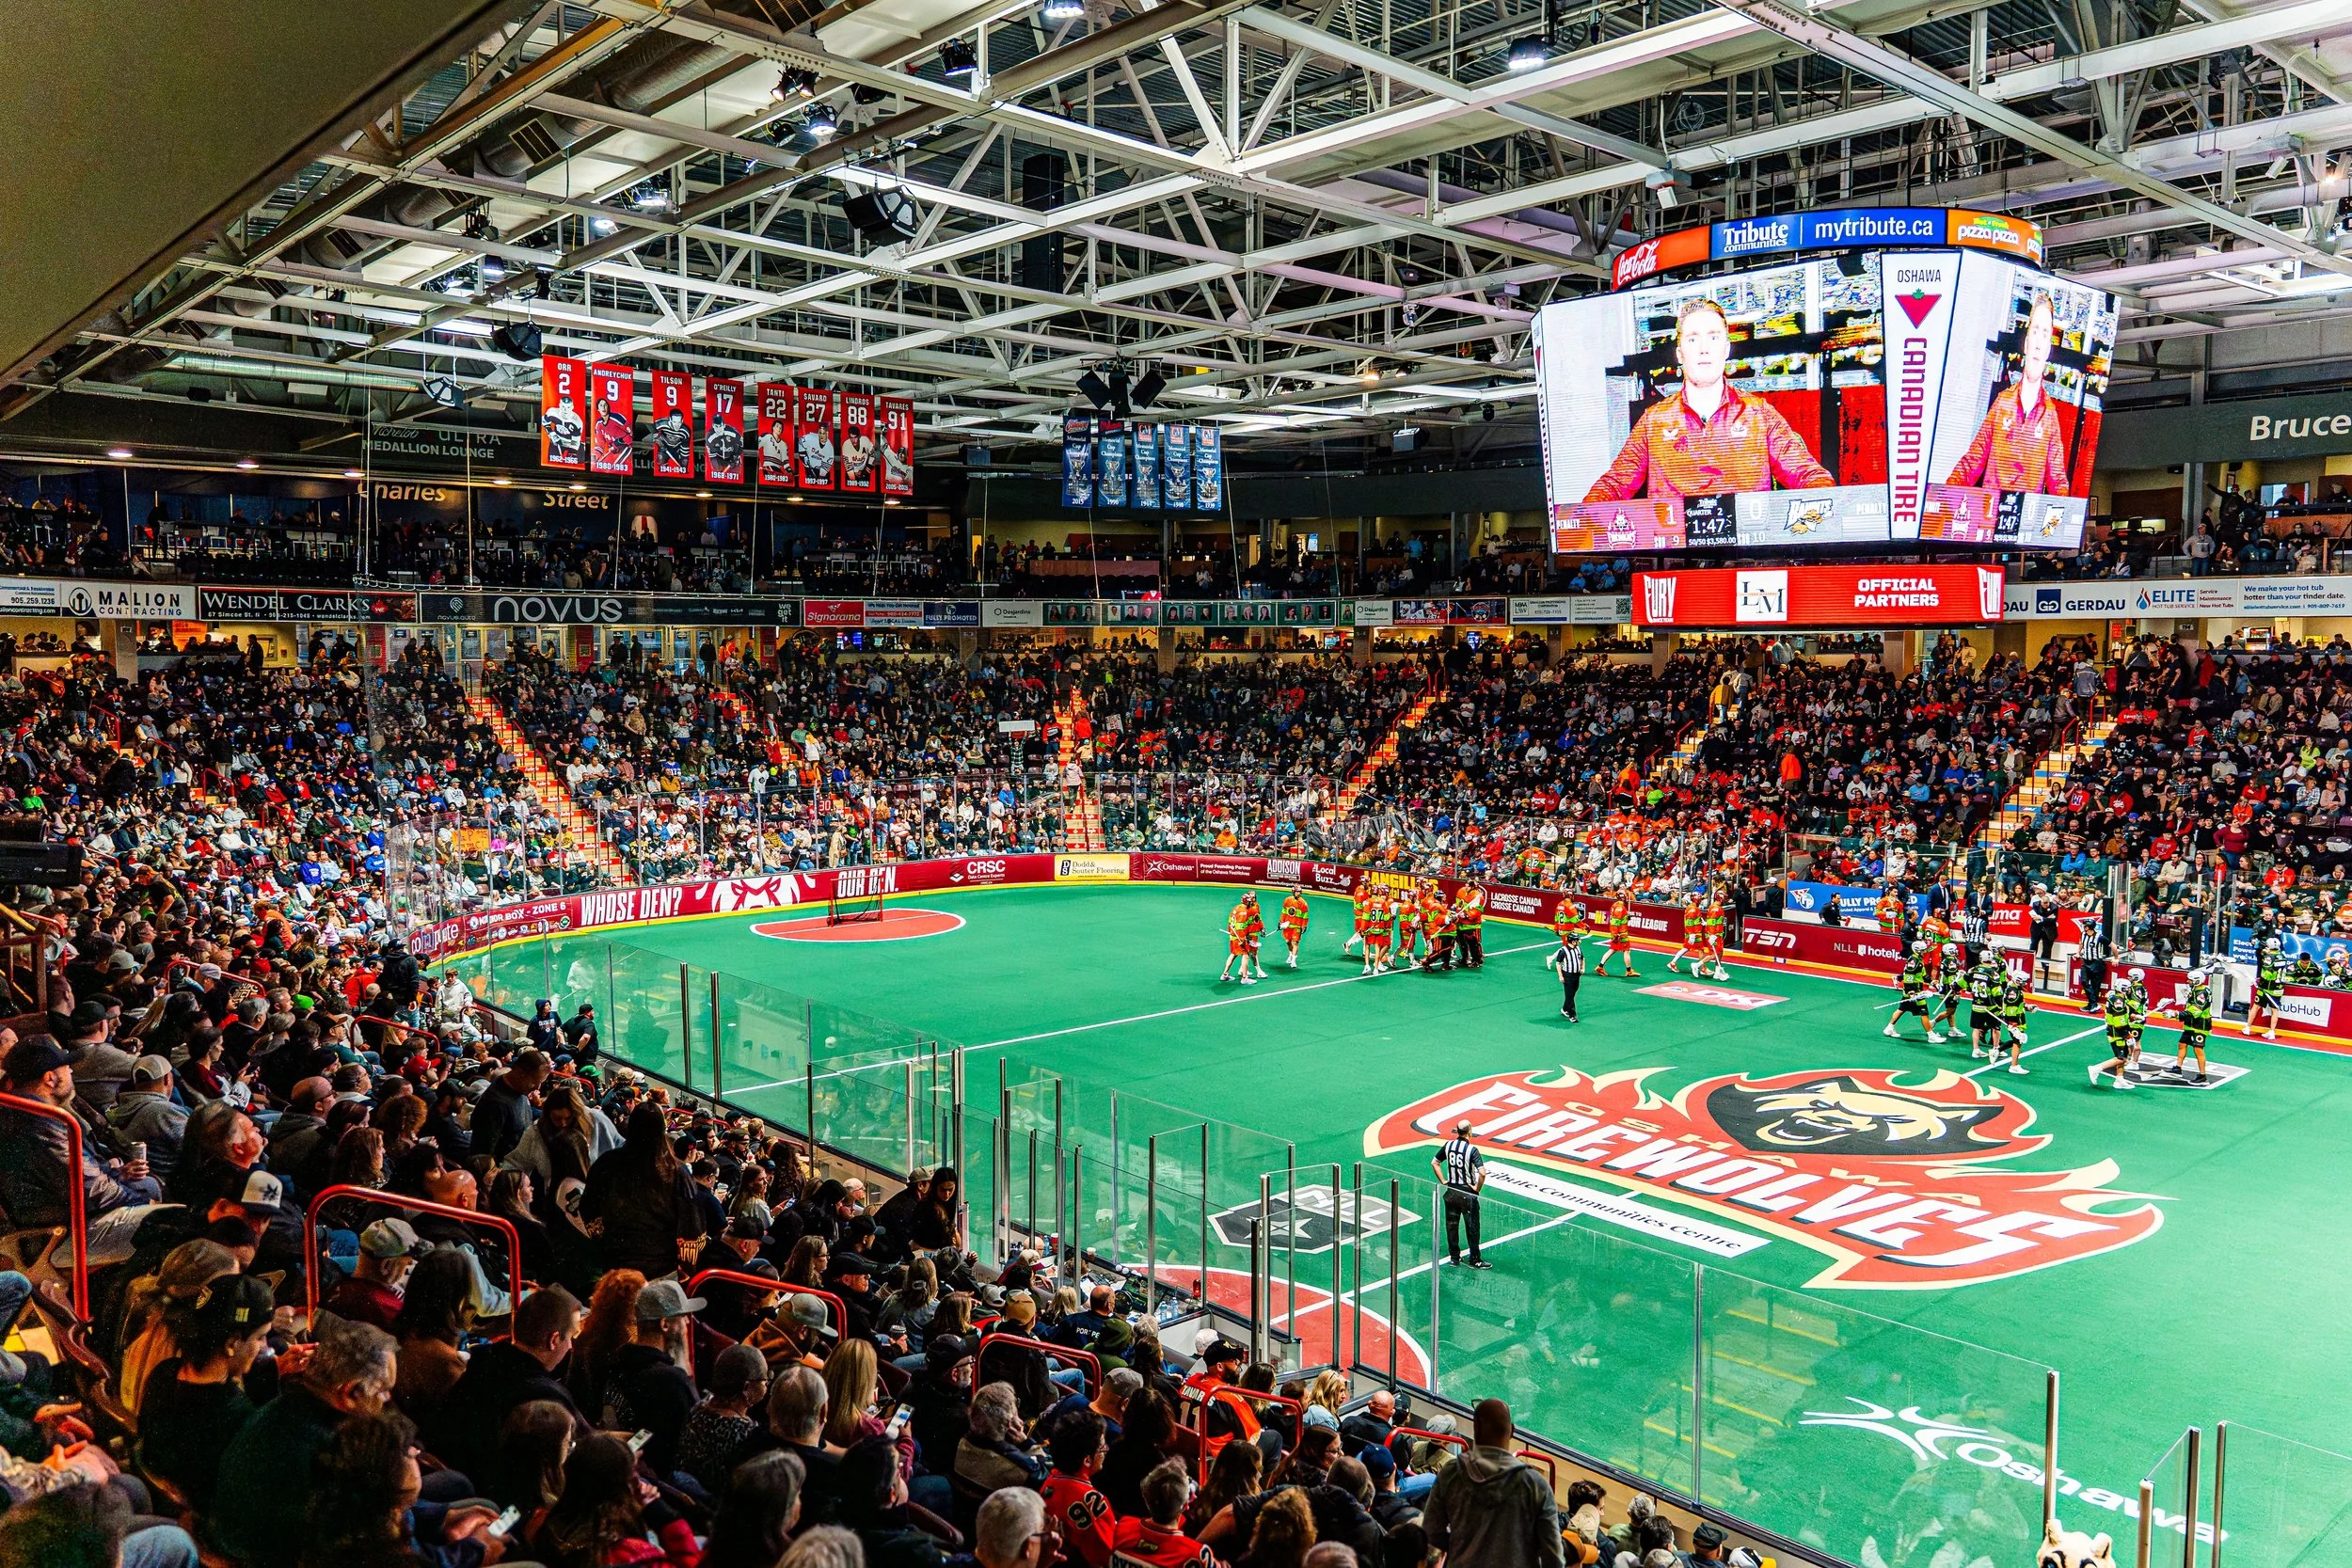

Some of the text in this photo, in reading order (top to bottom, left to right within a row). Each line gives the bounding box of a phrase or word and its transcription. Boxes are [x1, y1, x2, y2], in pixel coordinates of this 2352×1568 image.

[1723, 219, 1788, 245] Tribute
[1815, 216, 1933, 242] mytribute.ca
[1958, 225, 2019, 245] pizza pizza
[1724, 236, 1788, 253] communities
[1898, 269, 1941, 283] OSHAWA
[557, 362, 572, 372] ORR
[593, 369, 632, 381] ANDREYCHUK
[660, 375, 683, 386] TILSON
[558, 373, 571, 395] 2
[606, 380, 619, 403] 9
[713, 383, 737, 393] O'REILLY
[666, 386, 678, 407] 9
[766, 388, 785, 398] TANTI
[803, 392, 827, 403] SAVARD
[716, 392, 734, 414] 17
[765, 398, 787, 419] 22
[845, 396, 870, 406] LINDROS
[885, 402, 910, 411] TAVARES
[805, 403, 826, 423] 27
[848, 405, 867, 426] 88
[888, 411, 907, 431] 91
[2249, 414, 2352, 442] Bruce
[1893, 337, 1928, 522] CANADIAN TIRE
[362, 439, 495, 459] MEDALLION LOUNGE
[548, 454, 579, 465] 1962-1966
[596, 462, 628, 472] 1980-1983
[660, 466, 687, 474] 1941-1943
[710, 470, 739, 481] 1968-1971
[804, 477, 828, 485] 1993-1997
[543, 492, 610, 510] Street
[1856, 502, 1887, 515] PENALTY
[1986, 496, 1994, 518] 1
[1665, 504, 1677, 526] 1
[1717, 508, 1724, 516] 2
[1748, 499, 1762, 520] 0
[1556, 519, 1581, 530] PENALTY
[1692, 518, 1725, 534] 1:47
[1997, 515, 2017, 531] 1:47
[1672, 535, 1680, 546] 9
[1706, 537, 1737, 546] $3,580.00
[1753, 532, 1766, 543] 10
[1858, 578, 1937, 593] OFFICIAL
[99, 591, 181, 608] MALION
[202, 592, 370, 611] WENDEL CLARK'S
[1644, 574, 1677, 619] FURY
[1854, 594, 1940, 608] PARTNERS
[2152, 590, 2196, 603] ELITE
[99, 607, 182, 616] CONTRACTING
[2065, 598, 2126, 612] GERDAU
[807, 611, 861, 623] Signarama
[1563, 828, 1575, 839] 88
[966, 860, 1006, 874] CRSC
[1096, 866, 1125, 875] Flooring
[1162, 863, 1194, 871] Oshawa
[1267, 859, 1301, 875] ADDISON
[1315, 864, 1336, 876] Local
[837, 866, 899, 898] OUR DEN.
[1315, 873, 1334, 884] Buzz
[580, 886, 683, 927] WHOSE DEN?
[1490, 892, 1542, 908] LACROSSE CANADA
[1490, 900, 1535, 915] CROSSE CANADA
[1839, 896, 1862, 907] ULLY
[504, 901, 566, 922] BOX ZONE 6
[1370, 909, 1384, 923] 87
[1641, 918, 1669, 932] LEAGUE
[1743, 927, 1797, 950] TSN
[1971, 980, 1988, 998] 43
[2278, 1002, 2321, 1017] tubHub
[1448, 1152, 1464, 1168] 86
[1565, 1101, 1982, 1208] OSHAWA
[1412, 1081, 2121, 1268] FIREWOLVES
[1670, 1224, 1742, 1249] Centre
[1956, 1441, 2230, 1544] Oshawa
[1067, 1490, 1108, 1529] 92
